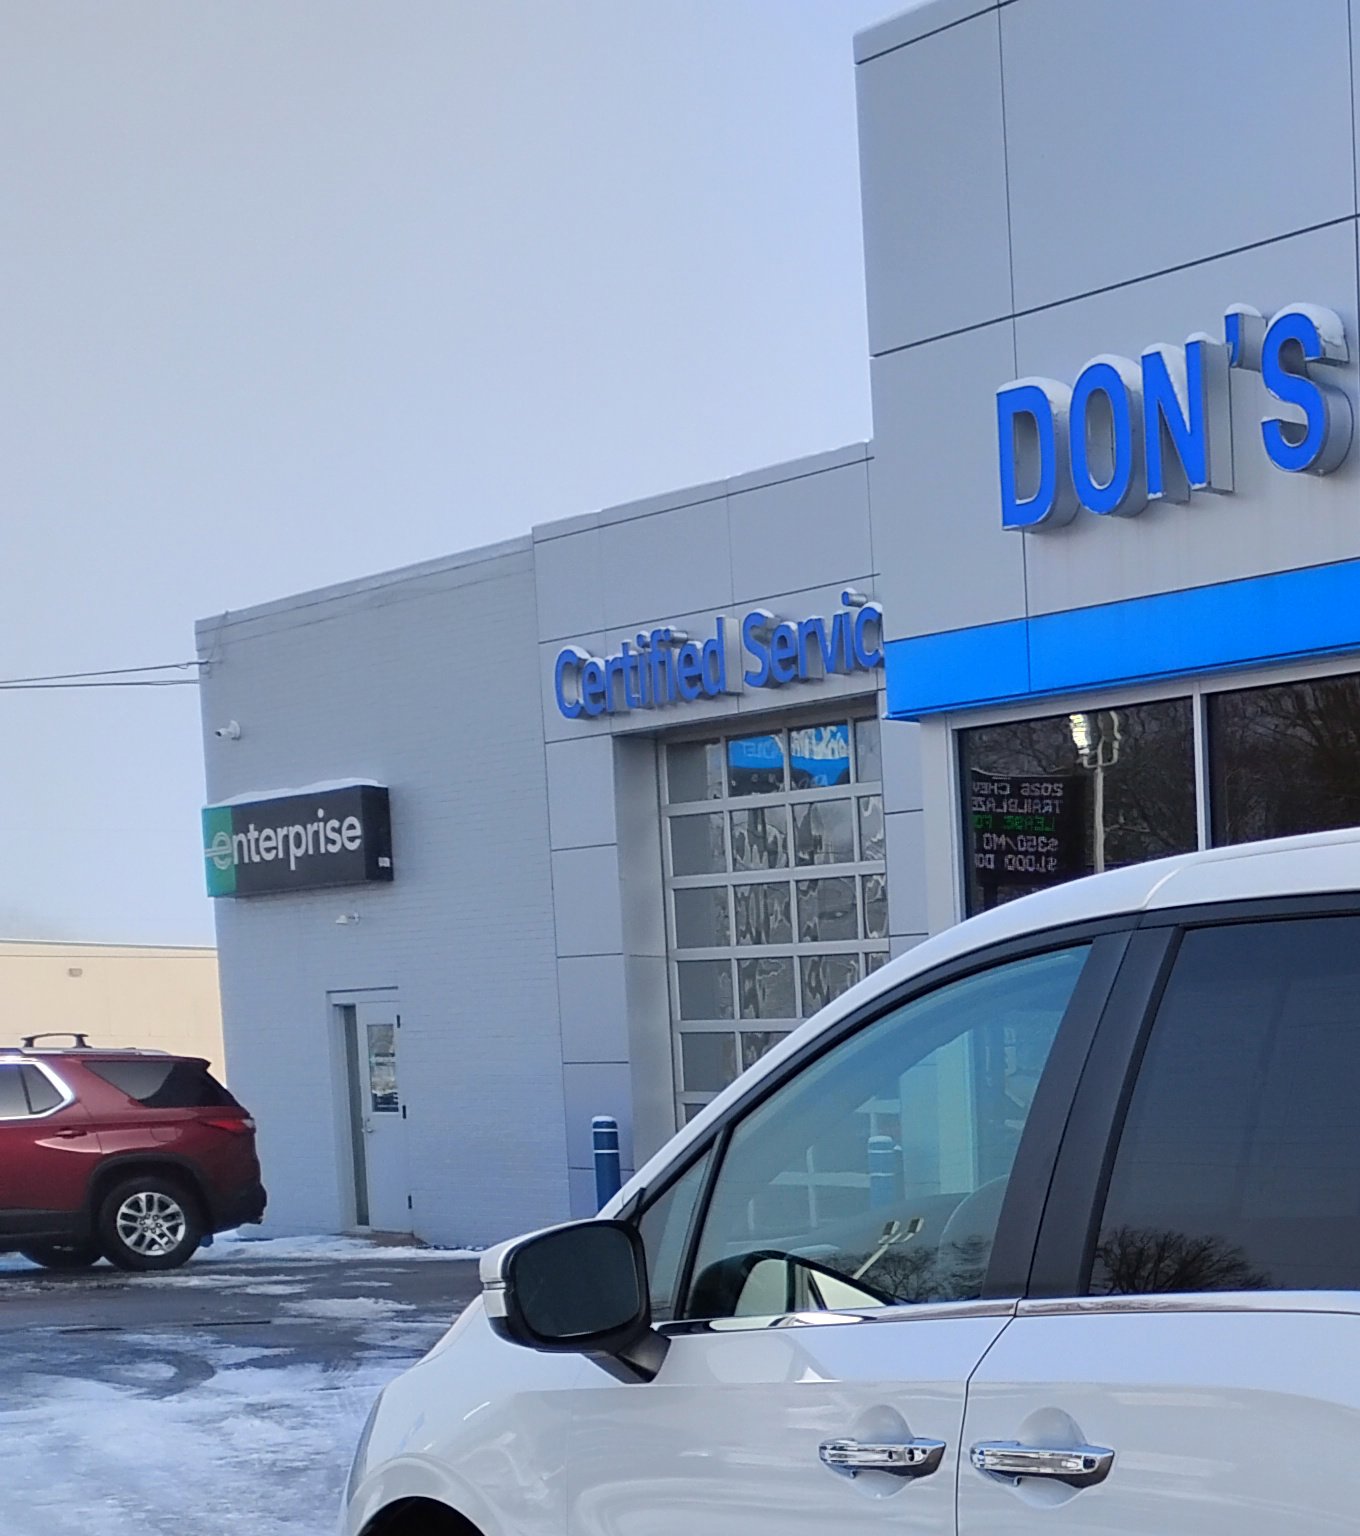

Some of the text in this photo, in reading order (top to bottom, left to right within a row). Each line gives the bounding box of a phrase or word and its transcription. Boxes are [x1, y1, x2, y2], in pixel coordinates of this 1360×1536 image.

[996, 306, 1332, 531] DON'S
[554, 588, 884, 720] Certified Servic
[205, 808, 363, 870] enterprise
